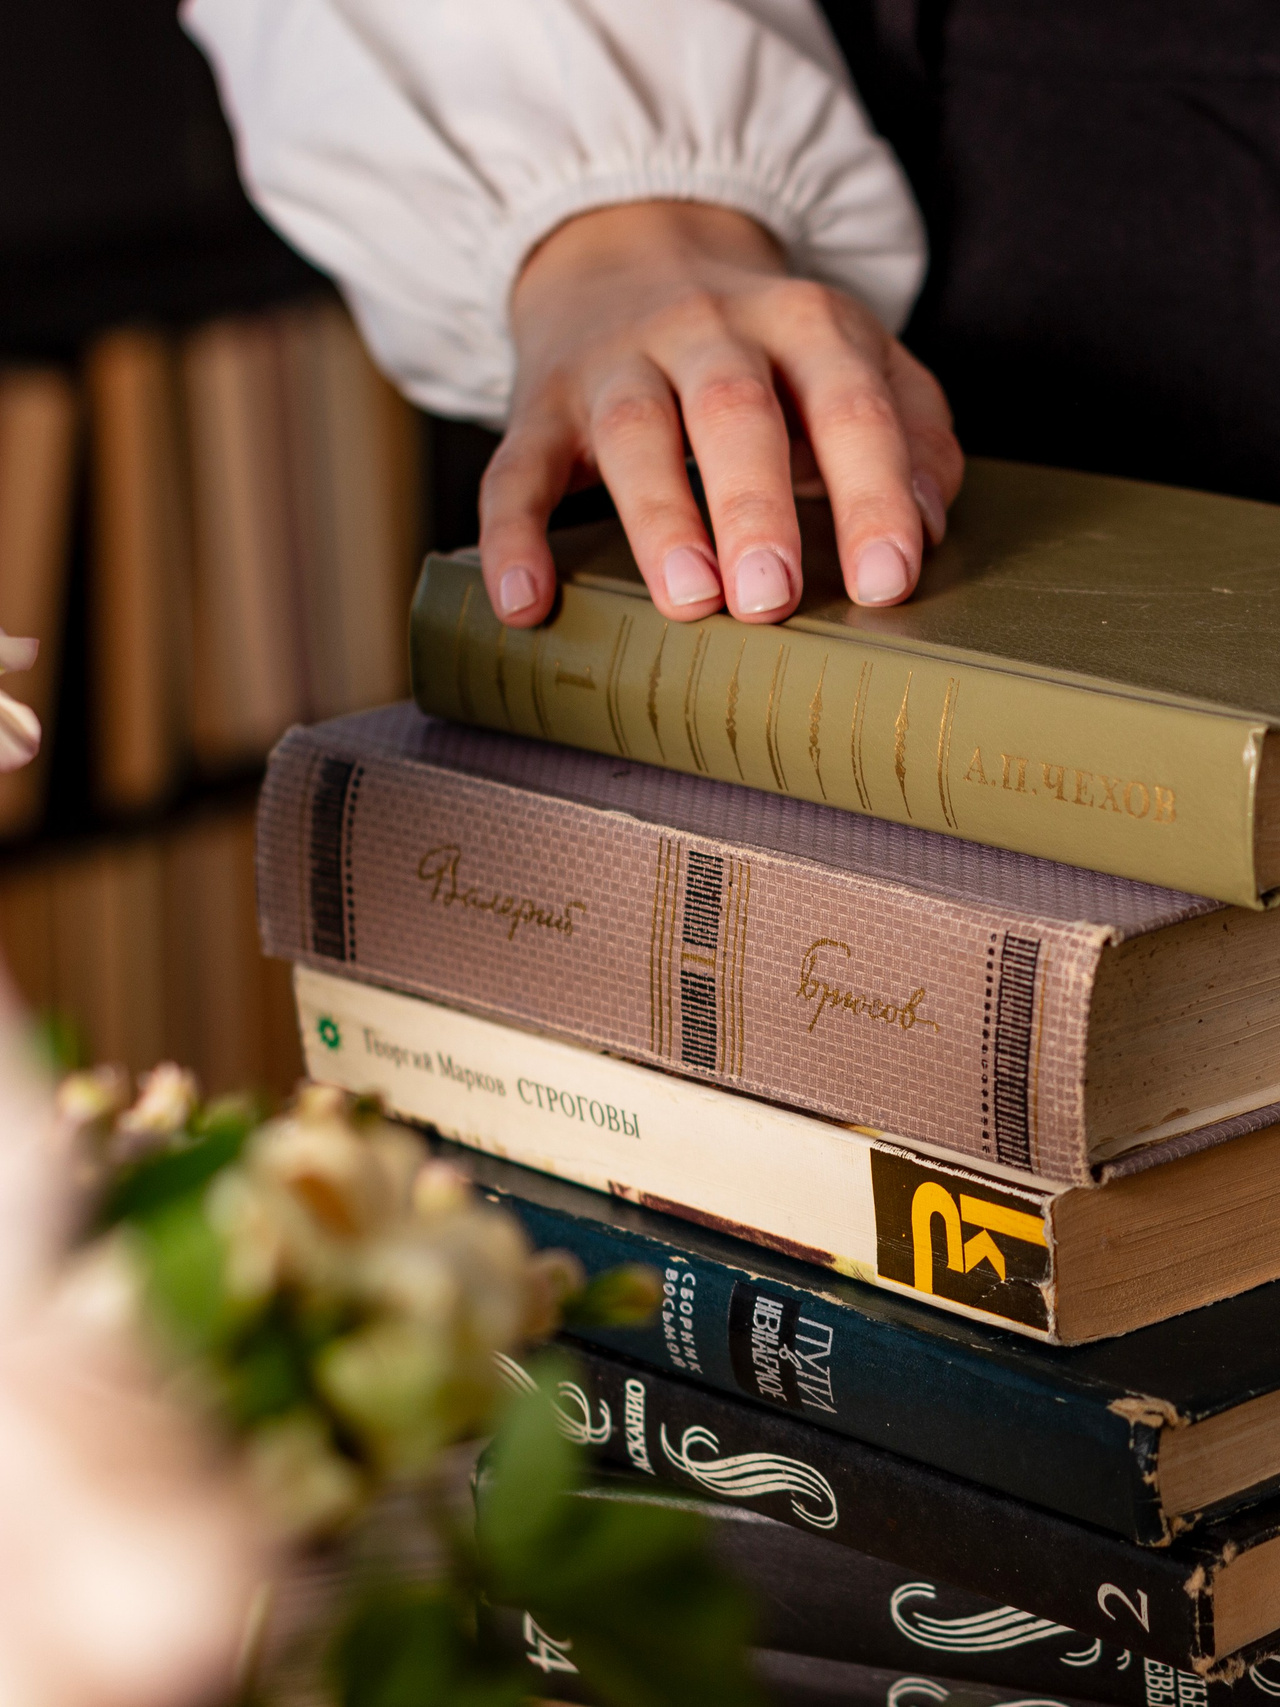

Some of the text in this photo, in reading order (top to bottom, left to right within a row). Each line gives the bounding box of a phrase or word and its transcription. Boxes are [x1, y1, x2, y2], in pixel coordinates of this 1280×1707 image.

[362, 1028, 641, 1139] Георгий Марков СТРОГОВЫ
[662, 1267, 687, 1368] ВОСЬМОЙ
[679, 1272, 703, 1374] СБОРНИК
[795, 1316, 838, 1414] ПУТИ
[624, 1378, 656, 1475] АСКАНИО
[1097, 1582, 1150, 1634] 2
